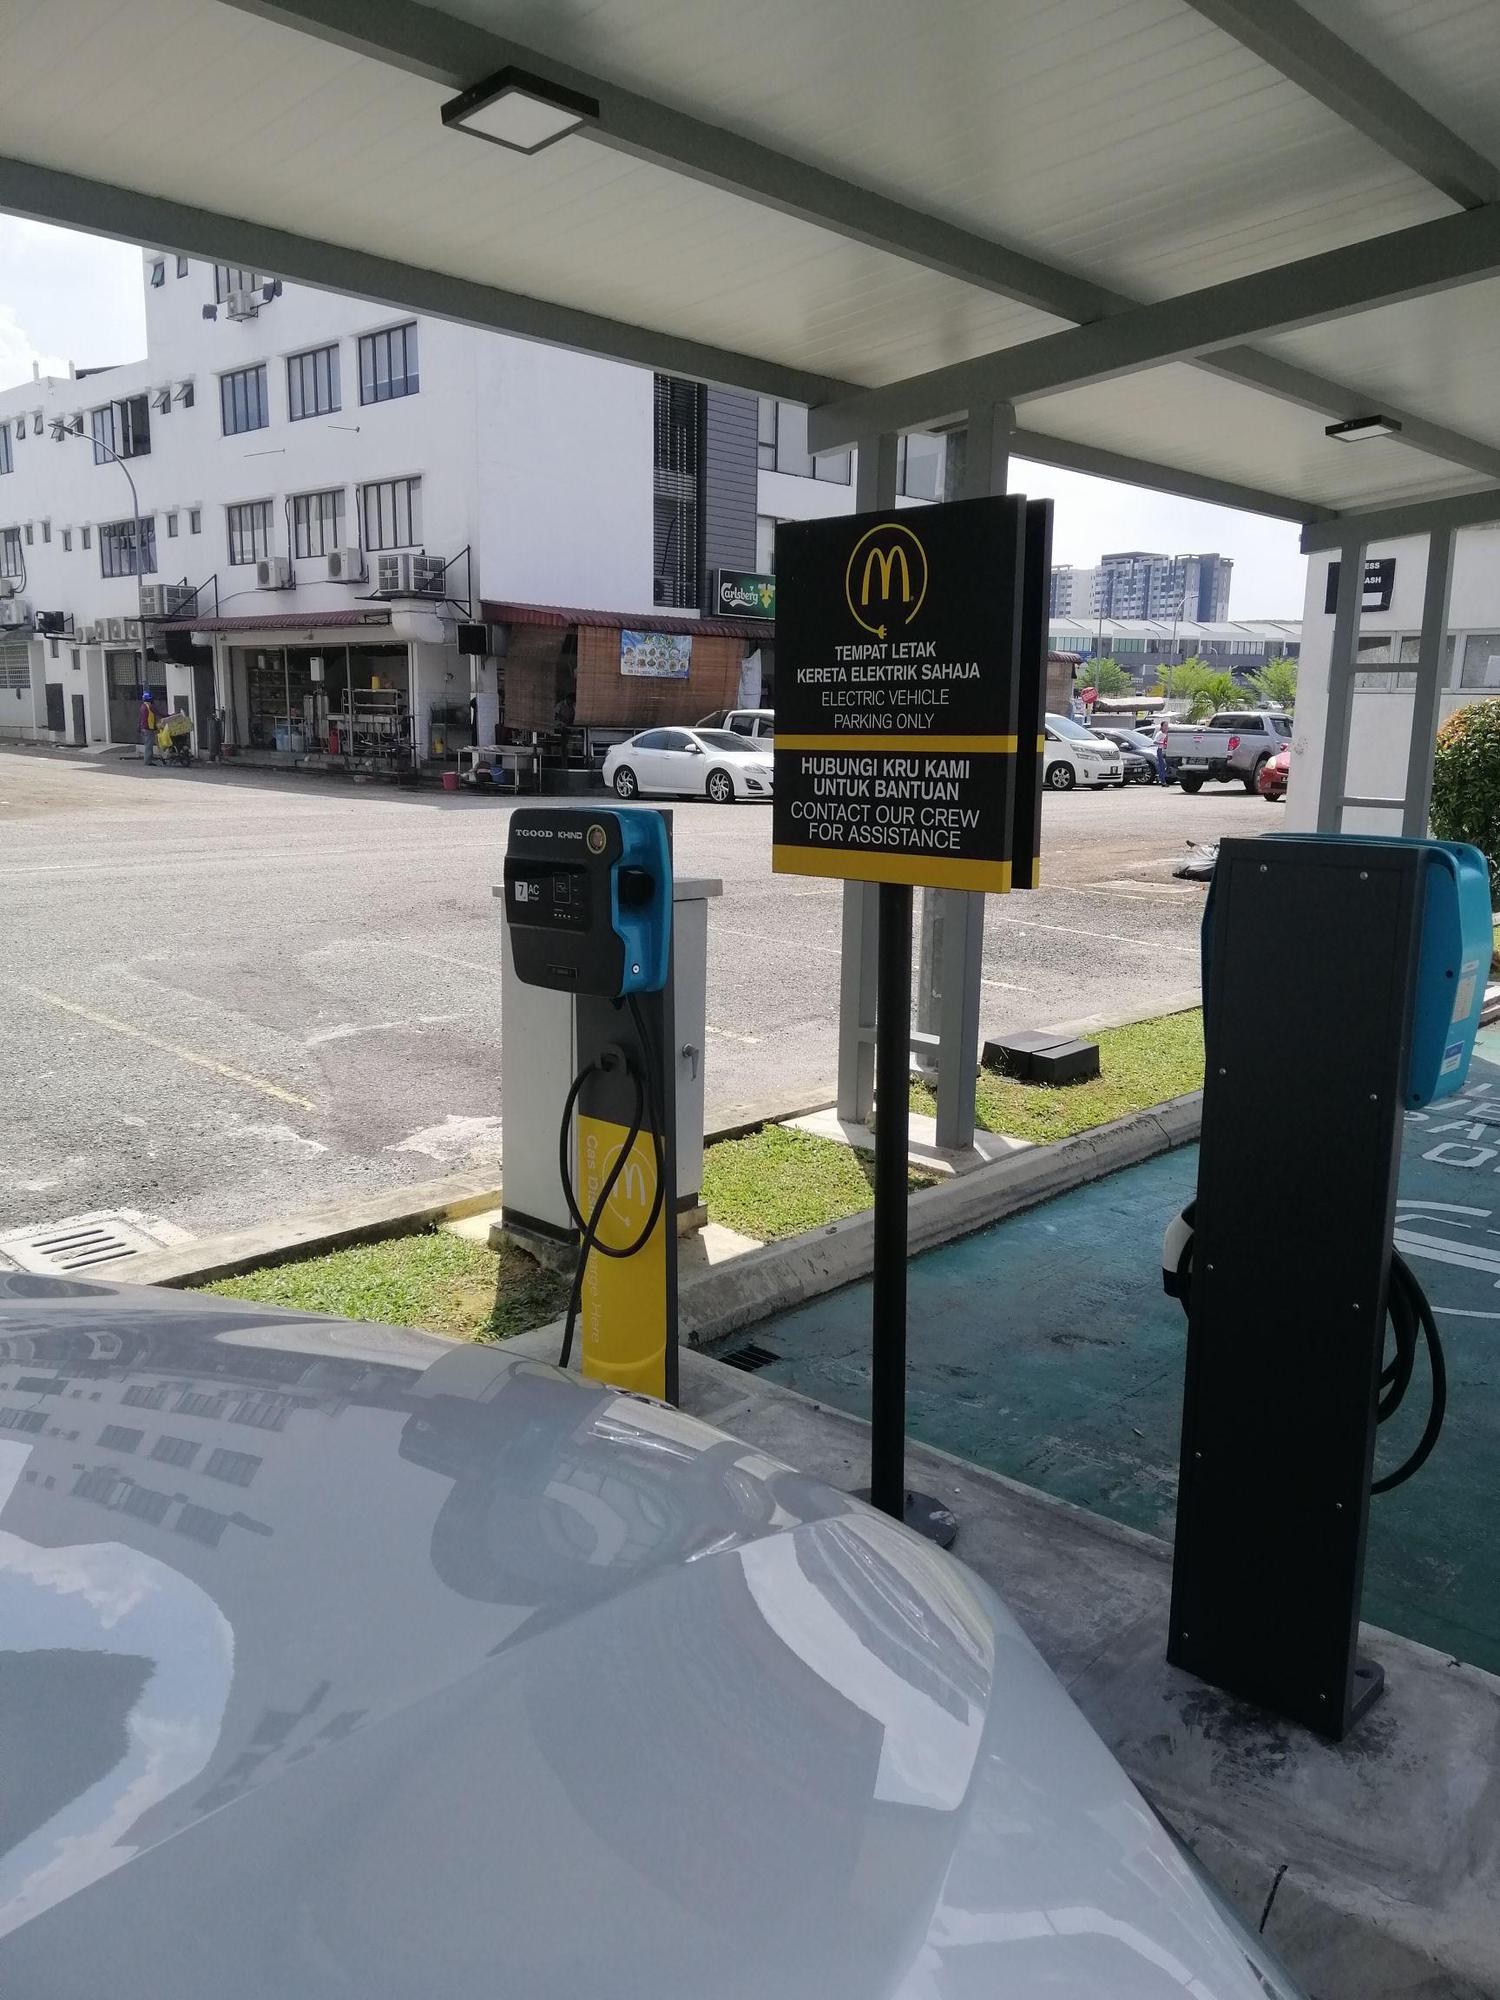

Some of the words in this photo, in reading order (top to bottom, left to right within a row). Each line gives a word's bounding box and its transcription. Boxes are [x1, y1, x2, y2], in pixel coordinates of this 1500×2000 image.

[1364, 576, 1382, 584] ASH
[721, 582, 759, 607] Carlsberg
[835, 644, 888, 661] TEMPAT
[892, 641, 936, 659] LETAK
[797, 667, 847, 683] KERETA
[851, 664, 918, 682] ELEKTRIK
[921, 662, 981, 680] SAHAJA
[821, 690, 885, 707] ELECTRIC
[889, 688, 950, 705] VEHICLE
[834, 713, 893, 729] PARKING
[896, 713, 935, 729] ONLY
[801, 757, 877, 777] HUBUNGI
[883, 758, 919, 777] KRU
[924, 759, 970, 779] KAMI
[813, 778, 870, 797] UNTUK
[874, 780, 959, 800] BANTUAN
[790, 801, 871, 822] CONTACT
[875, 805, 915, 825] OUR
[920, 807, 980, 828] CREW
[515, 829, 553, 838] TGOOD
[557, 831, 583, 839] KHIND
[809, 822, 843, 841] FOR
[848, 825, 961, 849] ASSISTANCE
[518, 884, 525, 896] 7
[528, 884, 540, 895] AC
